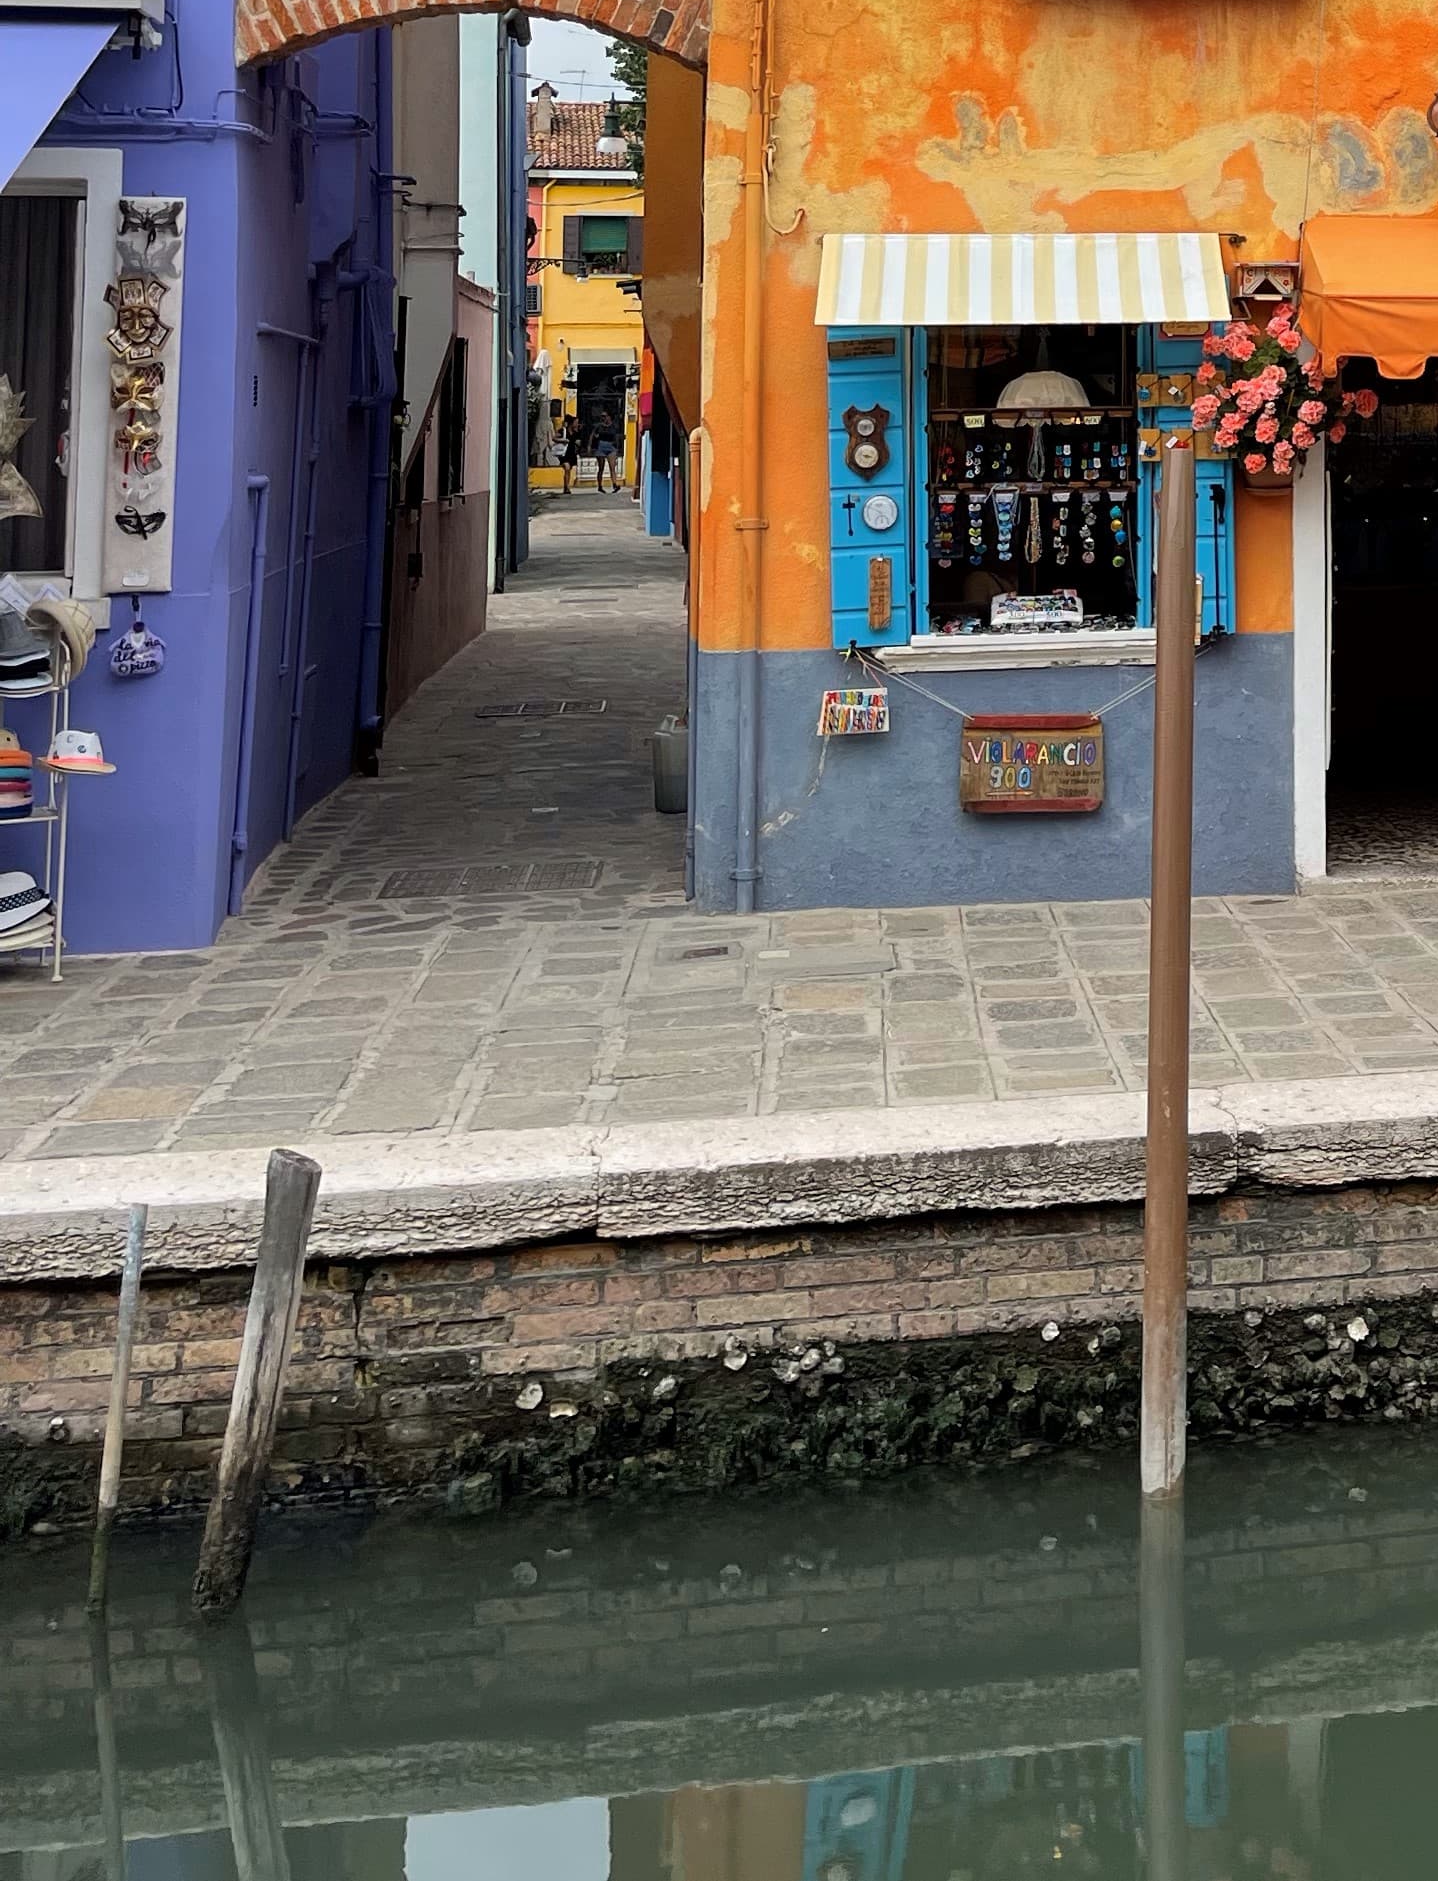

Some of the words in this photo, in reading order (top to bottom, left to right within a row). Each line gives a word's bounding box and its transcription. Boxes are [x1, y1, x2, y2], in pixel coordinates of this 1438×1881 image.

[119, 638, 134, 650] la
[144, 637, 161, 647] via
[114, 649, 137, 663] del
[967, 736, 1097, 766] VIOLARANCIO
[989, 765, 1032, 789] 900
